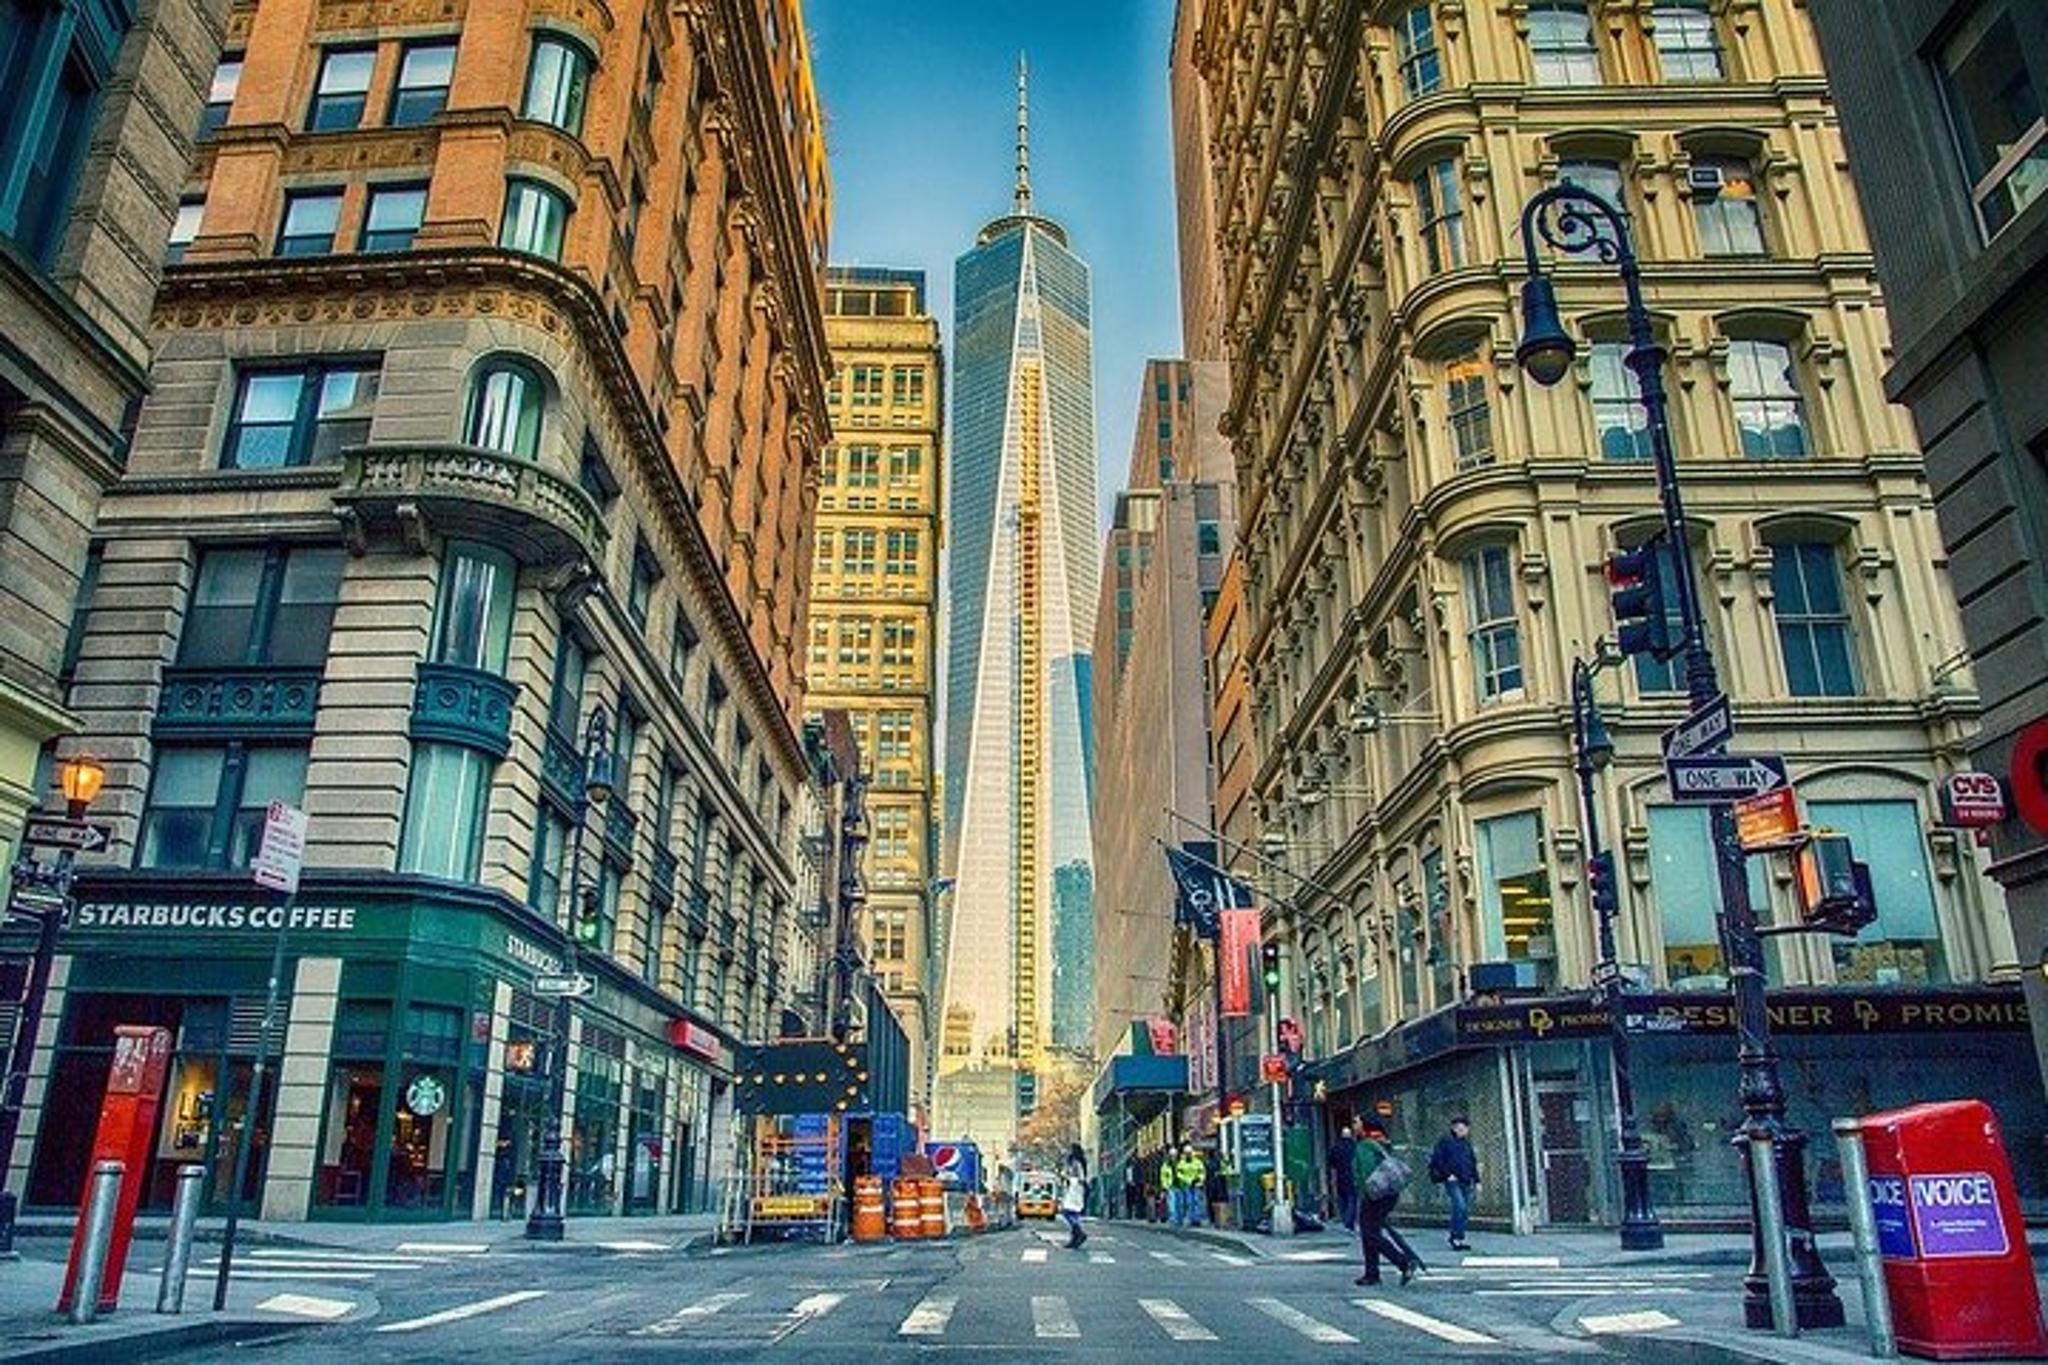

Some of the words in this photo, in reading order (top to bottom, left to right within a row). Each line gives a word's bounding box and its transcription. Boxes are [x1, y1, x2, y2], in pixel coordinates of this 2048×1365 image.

[1685, 769, 1722, 788] ONE
[1733, 769, 1769, 788] WAY
[1953, 776, 1997, 794] CVS
[79, 904, 246, 928] STARBUCKS
[249, 905, 357, 929] COFFEE
[1656, 1005, 1833, 1026] DESINER
